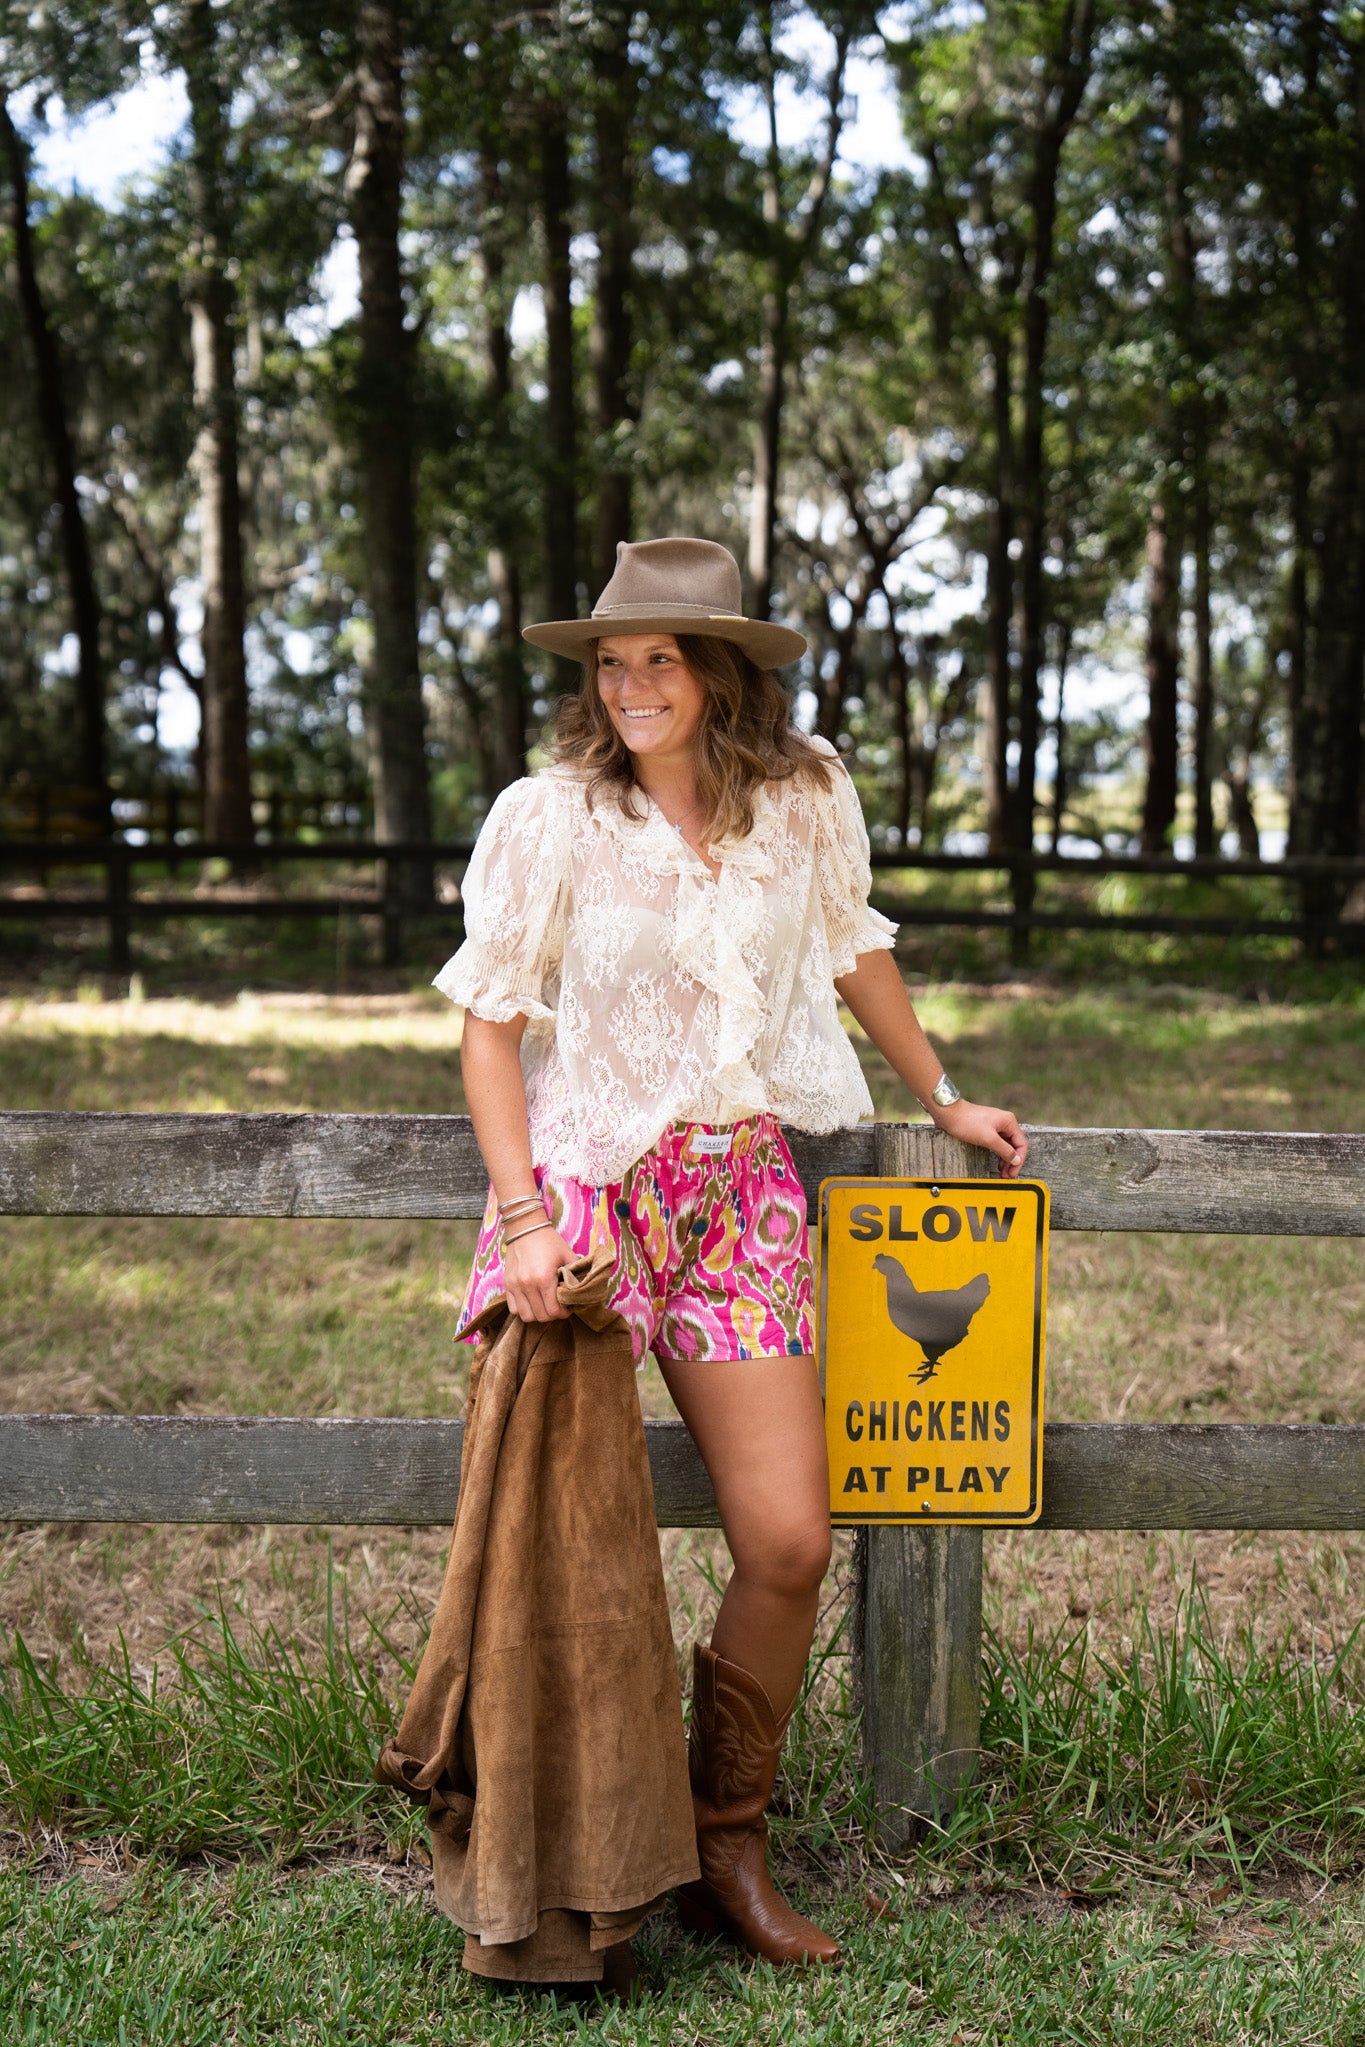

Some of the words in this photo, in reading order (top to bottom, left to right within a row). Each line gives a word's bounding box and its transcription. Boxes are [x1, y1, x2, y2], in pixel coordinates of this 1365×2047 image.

[849, 1204, 1017, 1243] SLOW
[846, 1400, 1011, 1442] CHICKENS
[843, 1467, 892, 1493] AT
[907, 1467, 1011, 1493] PLAY
